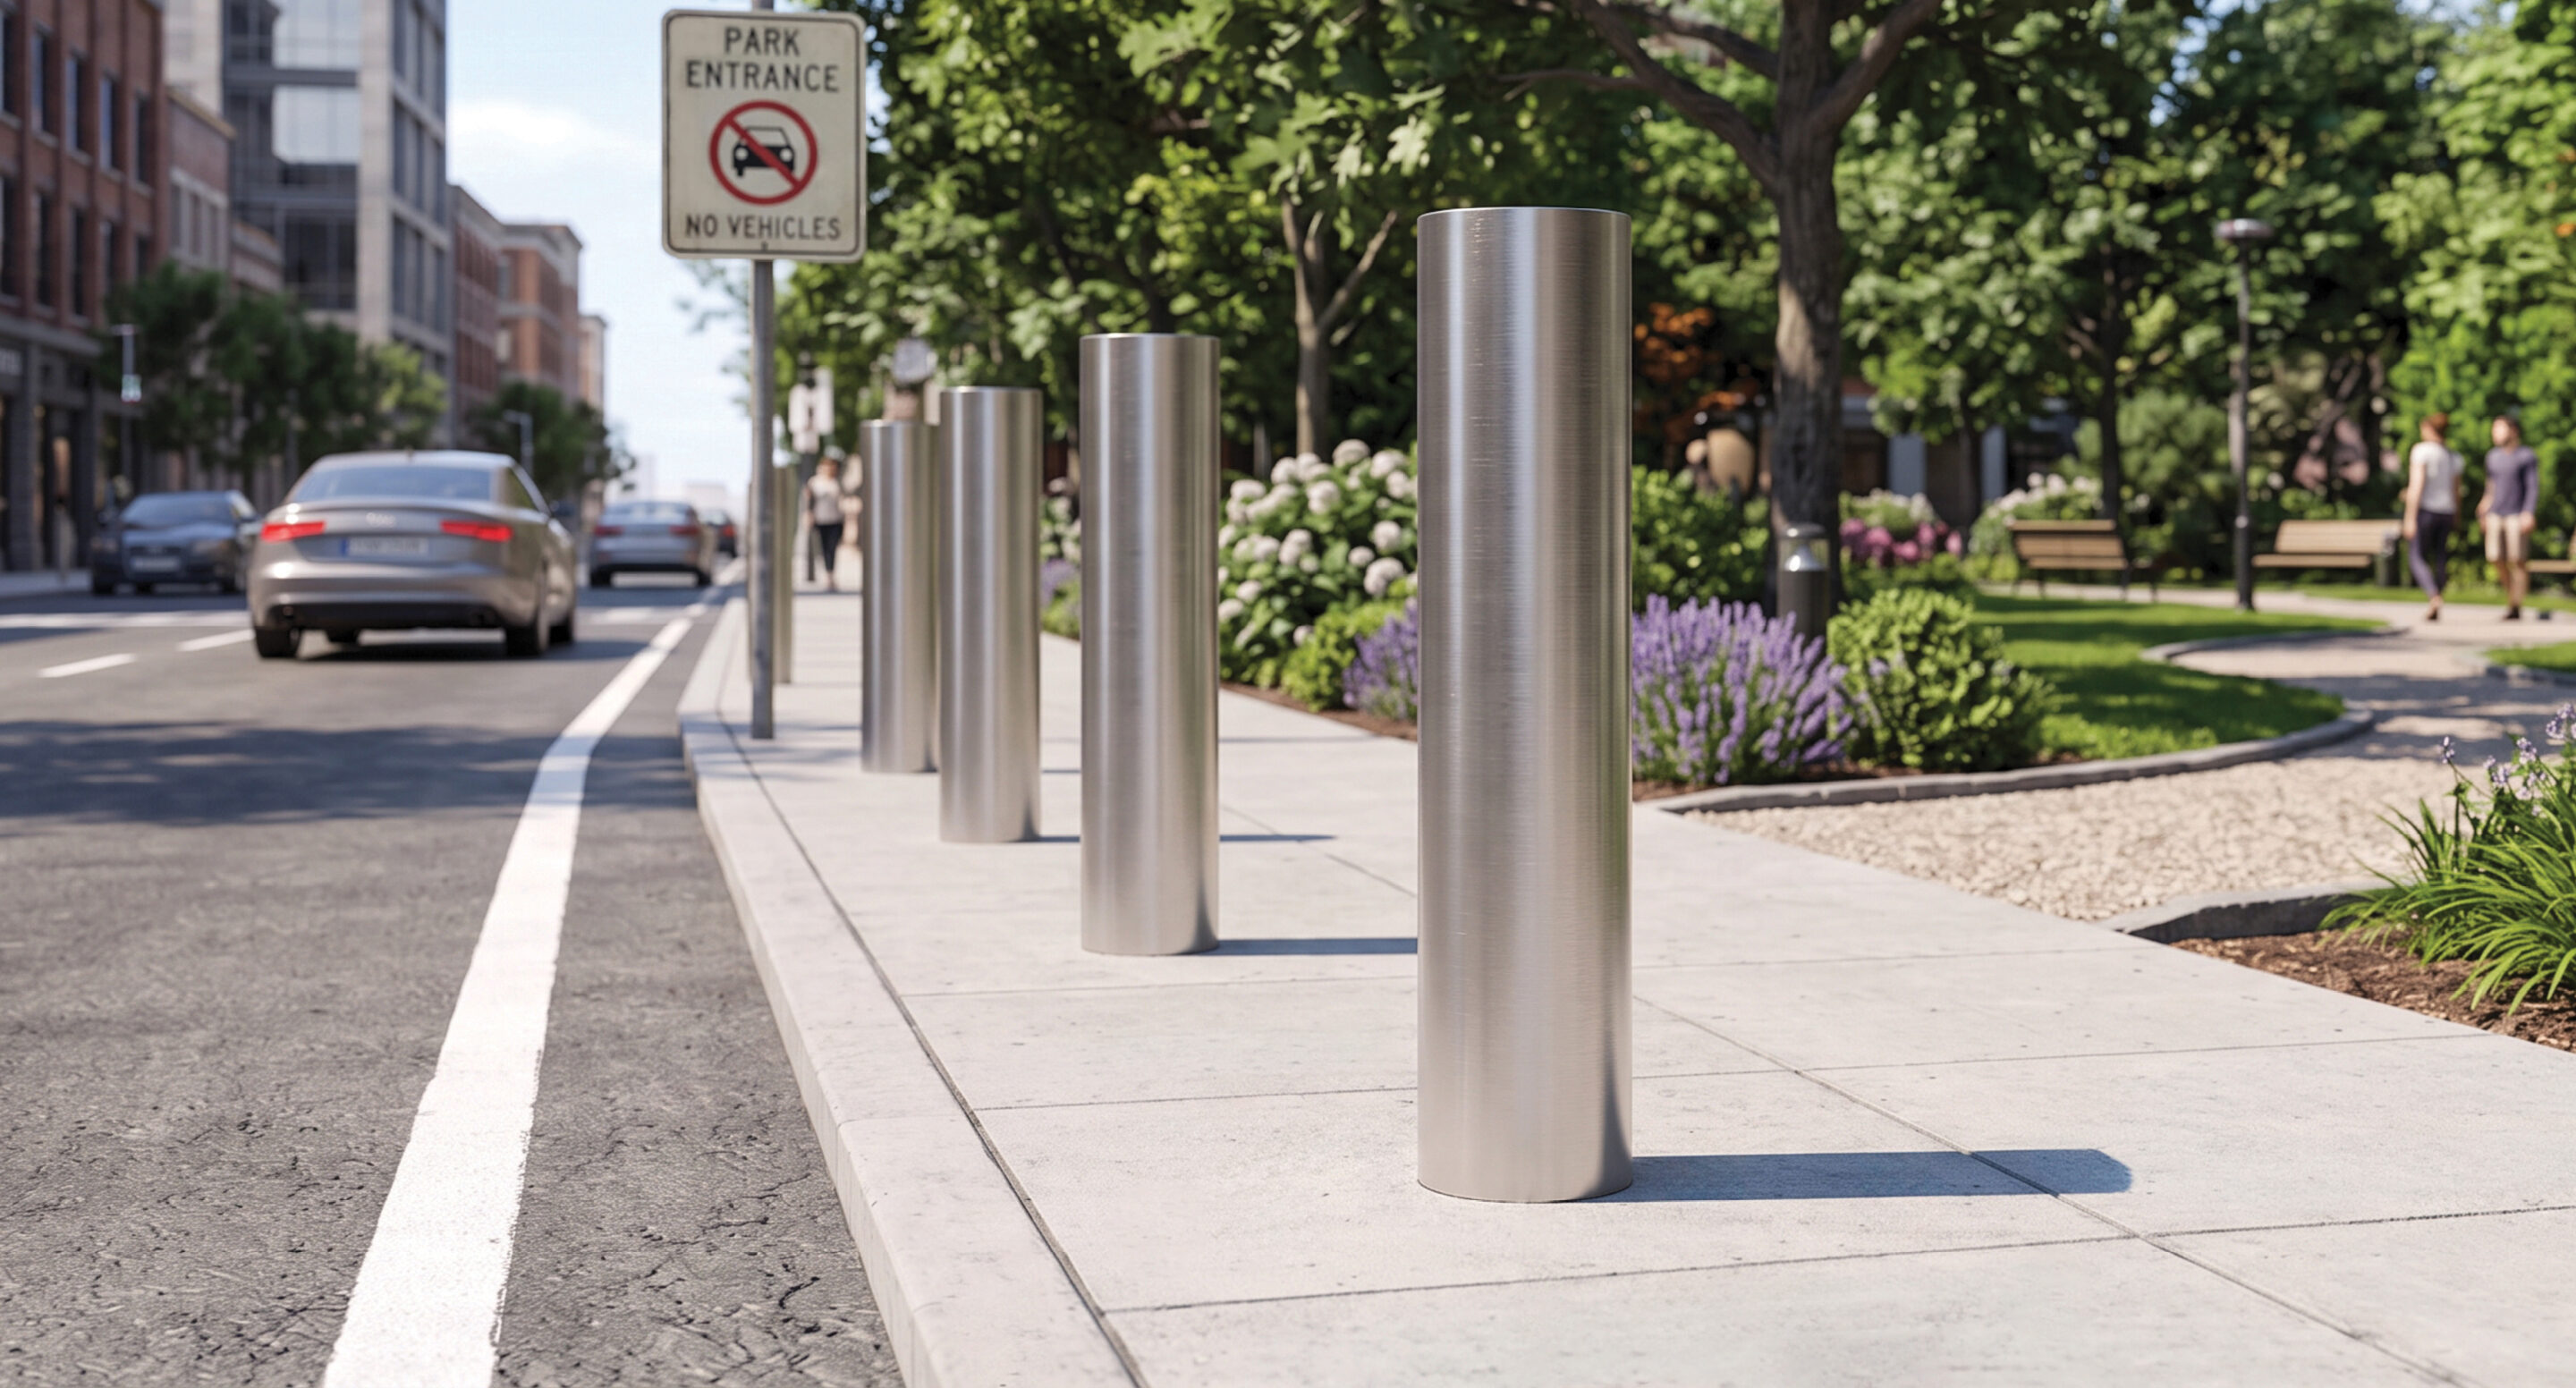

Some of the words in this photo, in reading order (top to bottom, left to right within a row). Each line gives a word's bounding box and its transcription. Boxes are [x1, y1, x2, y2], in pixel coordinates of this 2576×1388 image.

[724, 27, 800, 56] PARK
[686, 60, 839, 92] ENTRANCE
[686, 215, 717, 238] NO
[728, 216, 840, 240] VEHICLES
